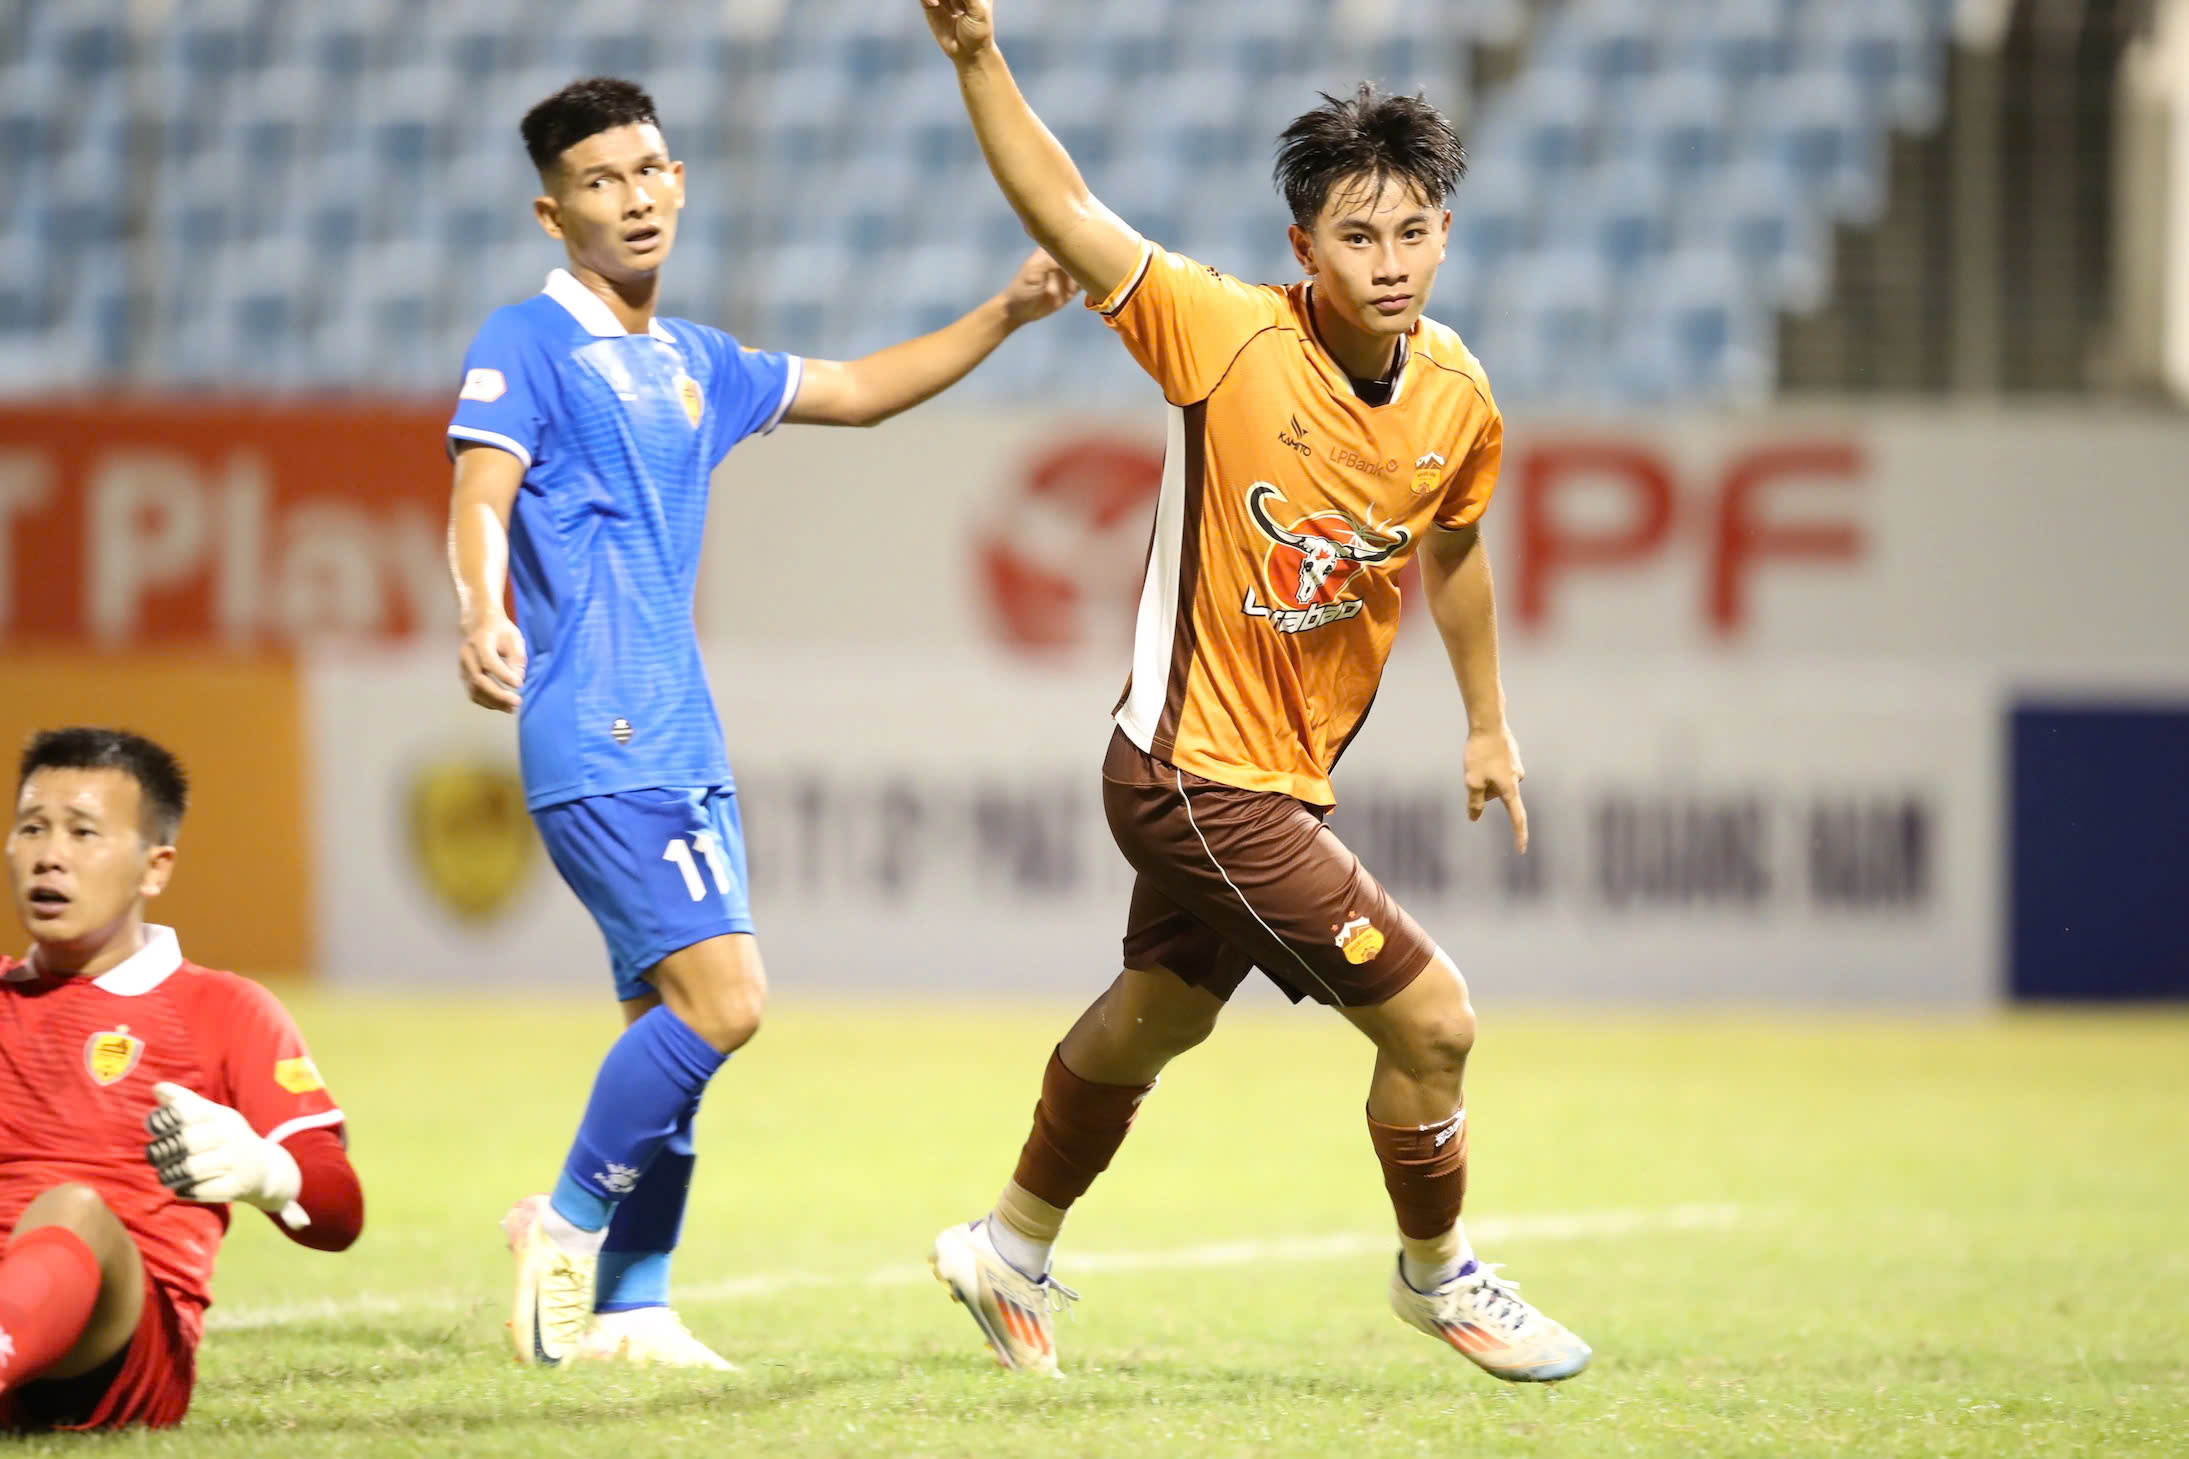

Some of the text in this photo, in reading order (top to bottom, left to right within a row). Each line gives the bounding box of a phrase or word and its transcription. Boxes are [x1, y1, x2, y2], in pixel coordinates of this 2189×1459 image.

[1278, 432, 1312, 457] KAMITO
[1329, 446, 1384, 477] LPBank
[1400, 434, 1872, 642] PF
[662, 833, 731, 902] 11
